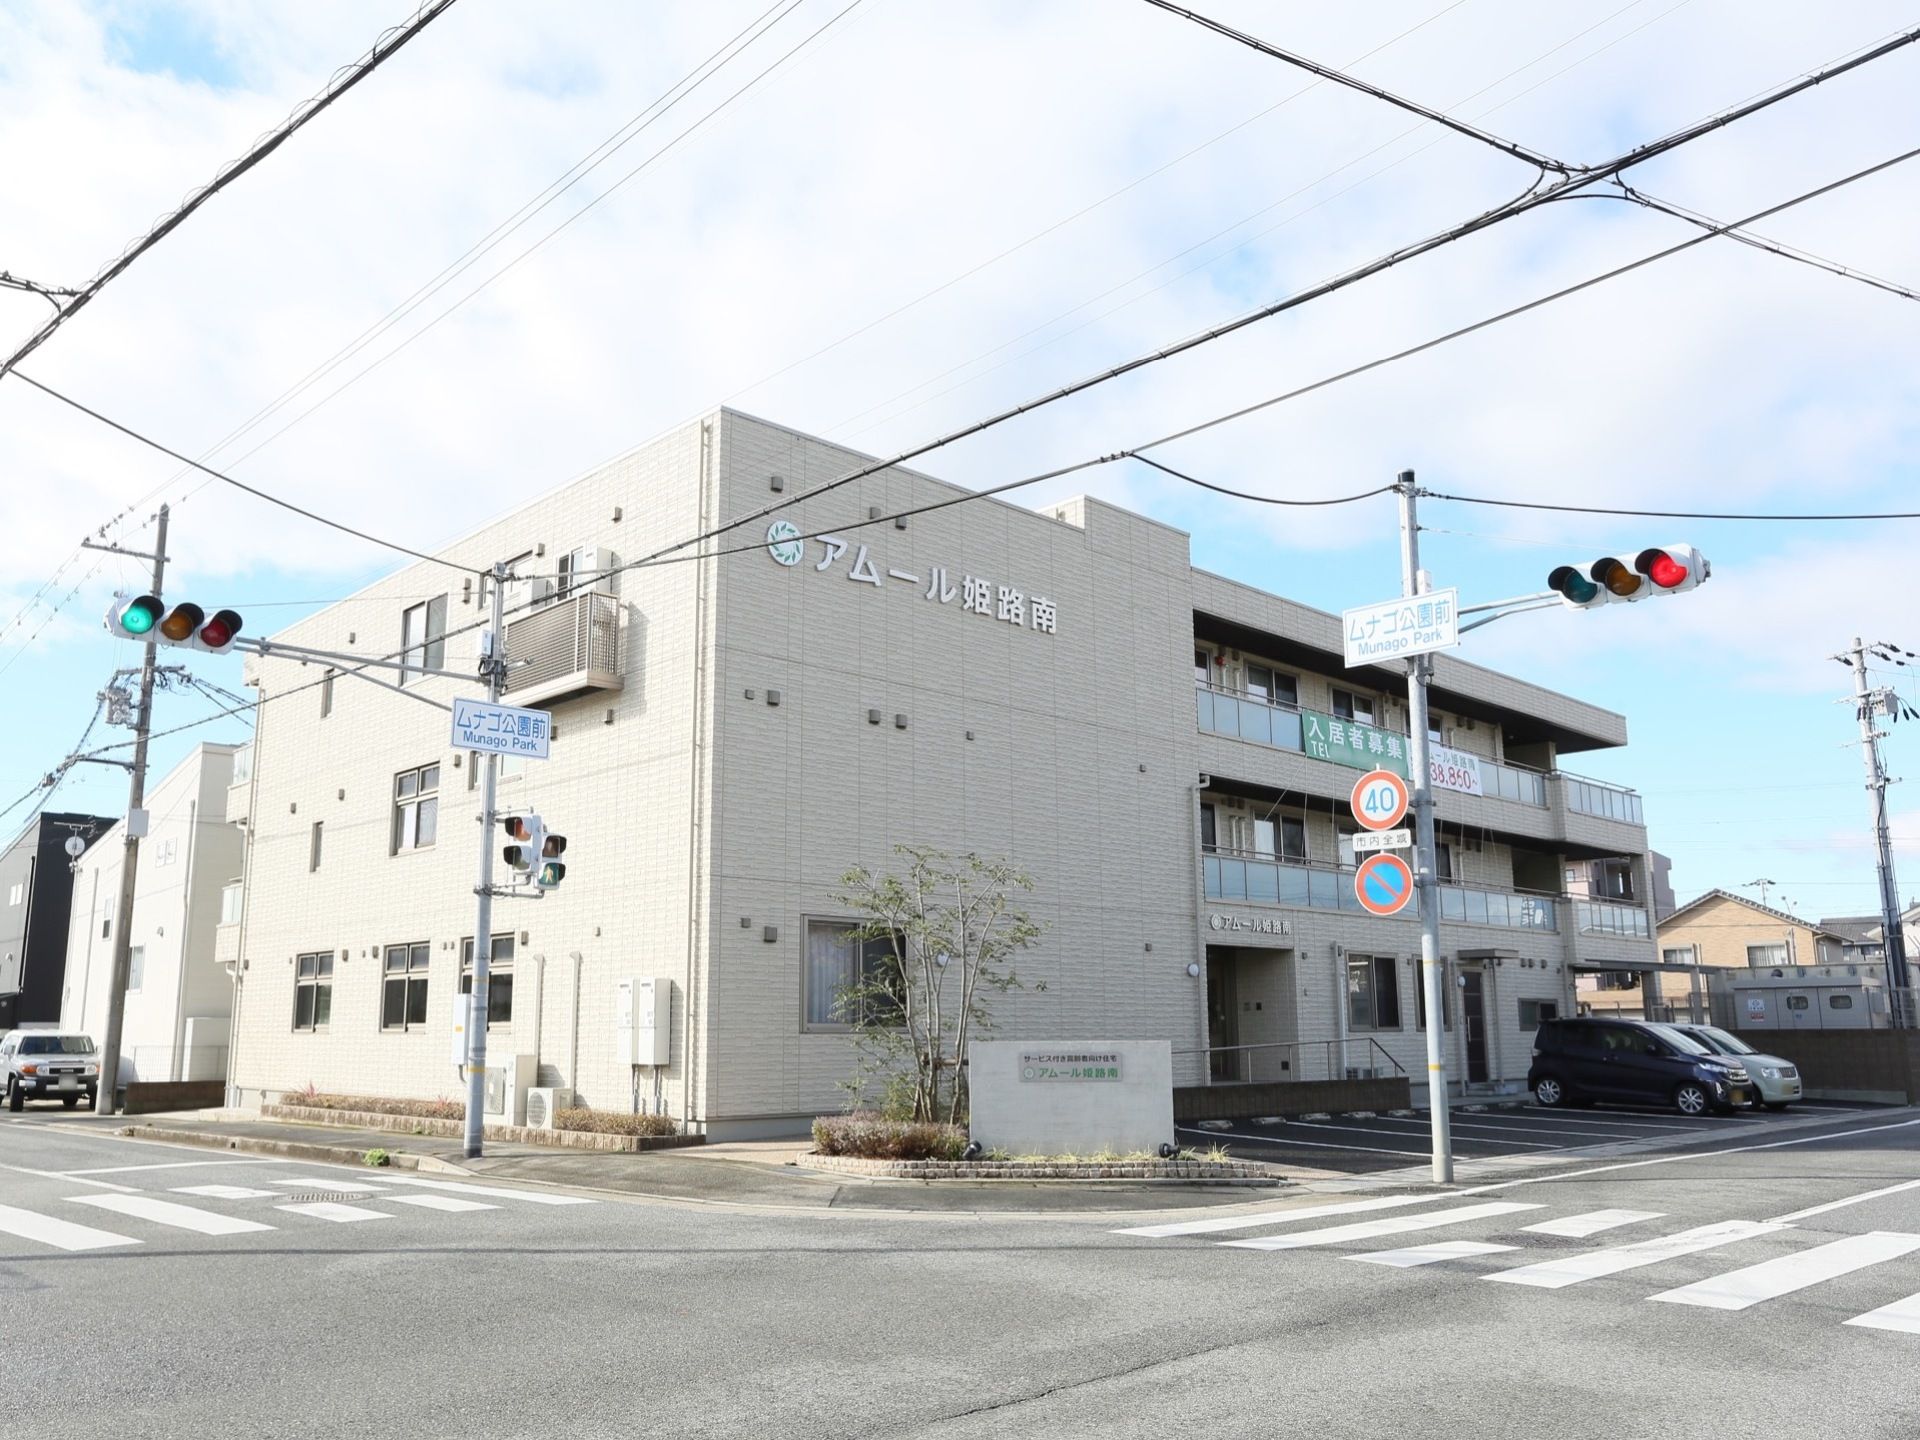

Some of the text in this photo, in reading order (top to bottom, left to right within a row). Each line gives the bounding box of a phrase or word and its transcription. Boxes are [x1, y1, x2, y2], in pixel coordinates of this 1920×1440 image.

[815, 534, 1057, 634] アムール姫路南
[1349, 599, 1451, 641] ムナゴ公園前
[1358, 628, 1442, 657] Munago Park
[456, 707, 546, 739] ムナゴ公園前
[463, 730, 537, 751] Munago Park
[1308, 716, 1403, 760] 入居者募集
[1311, 741, 1330, 758] TEL
[1365, 787, 1394, 812] 40
[1356, 833, 1408, 847] 市内全域
[1222, 915, 1291, 935] アムール姫路南
[1039, 1067, 1118, 1078] アムール姫路南
